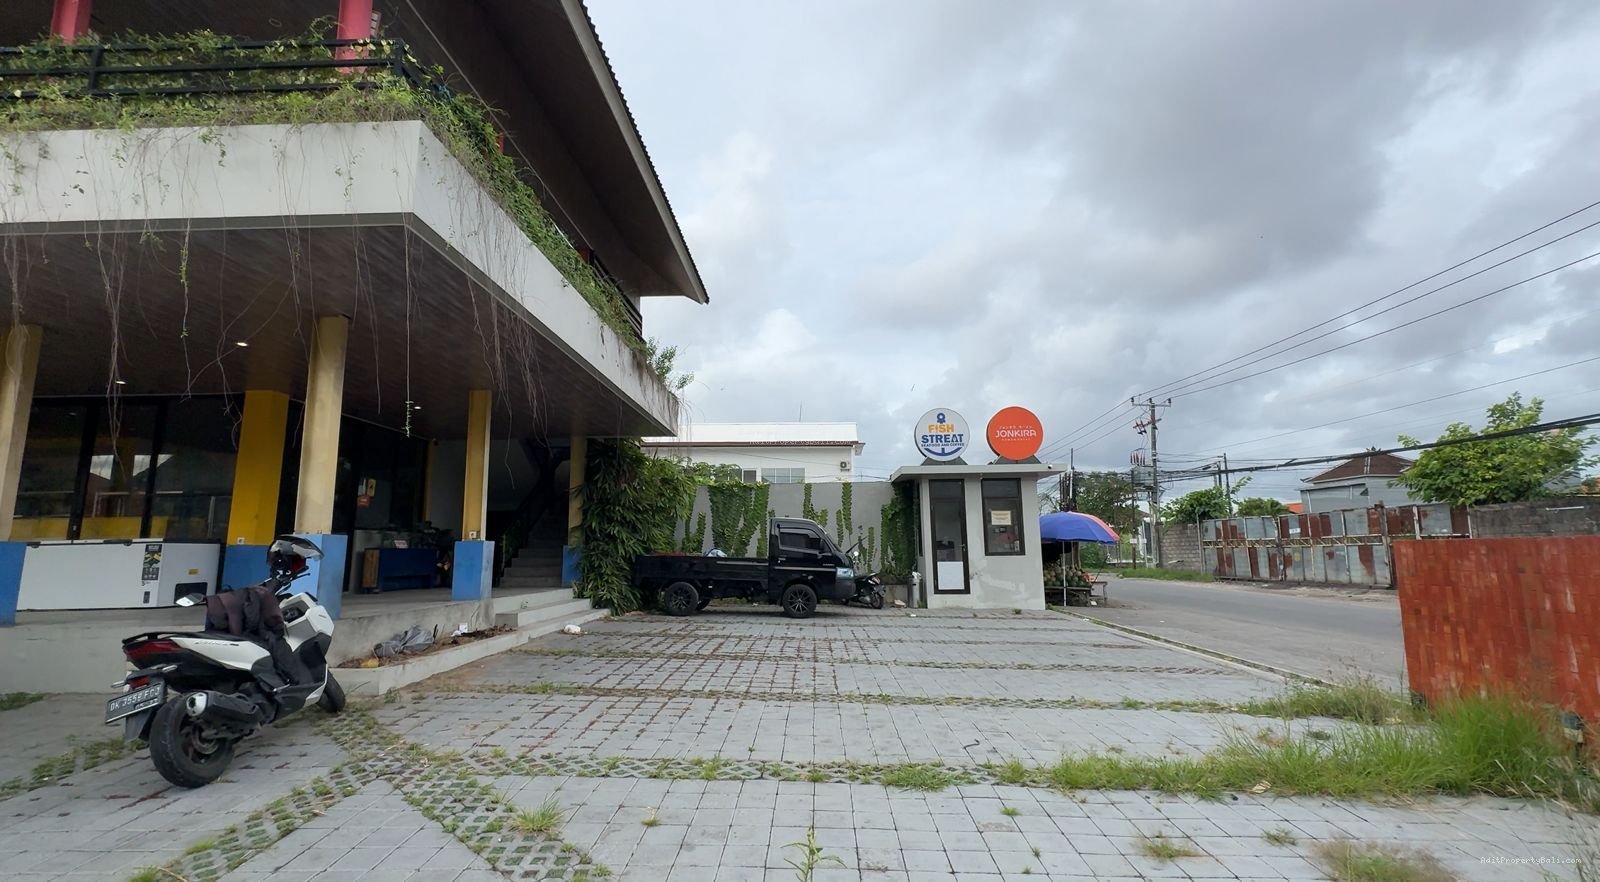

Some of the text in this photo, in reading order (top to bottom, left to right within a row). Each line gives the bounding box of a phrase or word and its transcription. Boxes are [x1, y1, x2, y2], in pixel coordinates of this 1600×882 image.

[928, 424, 954, 433] FISH
[995, 430, 1037, 438] JONKIRA
[921, 434, 964, 444] STREAT
